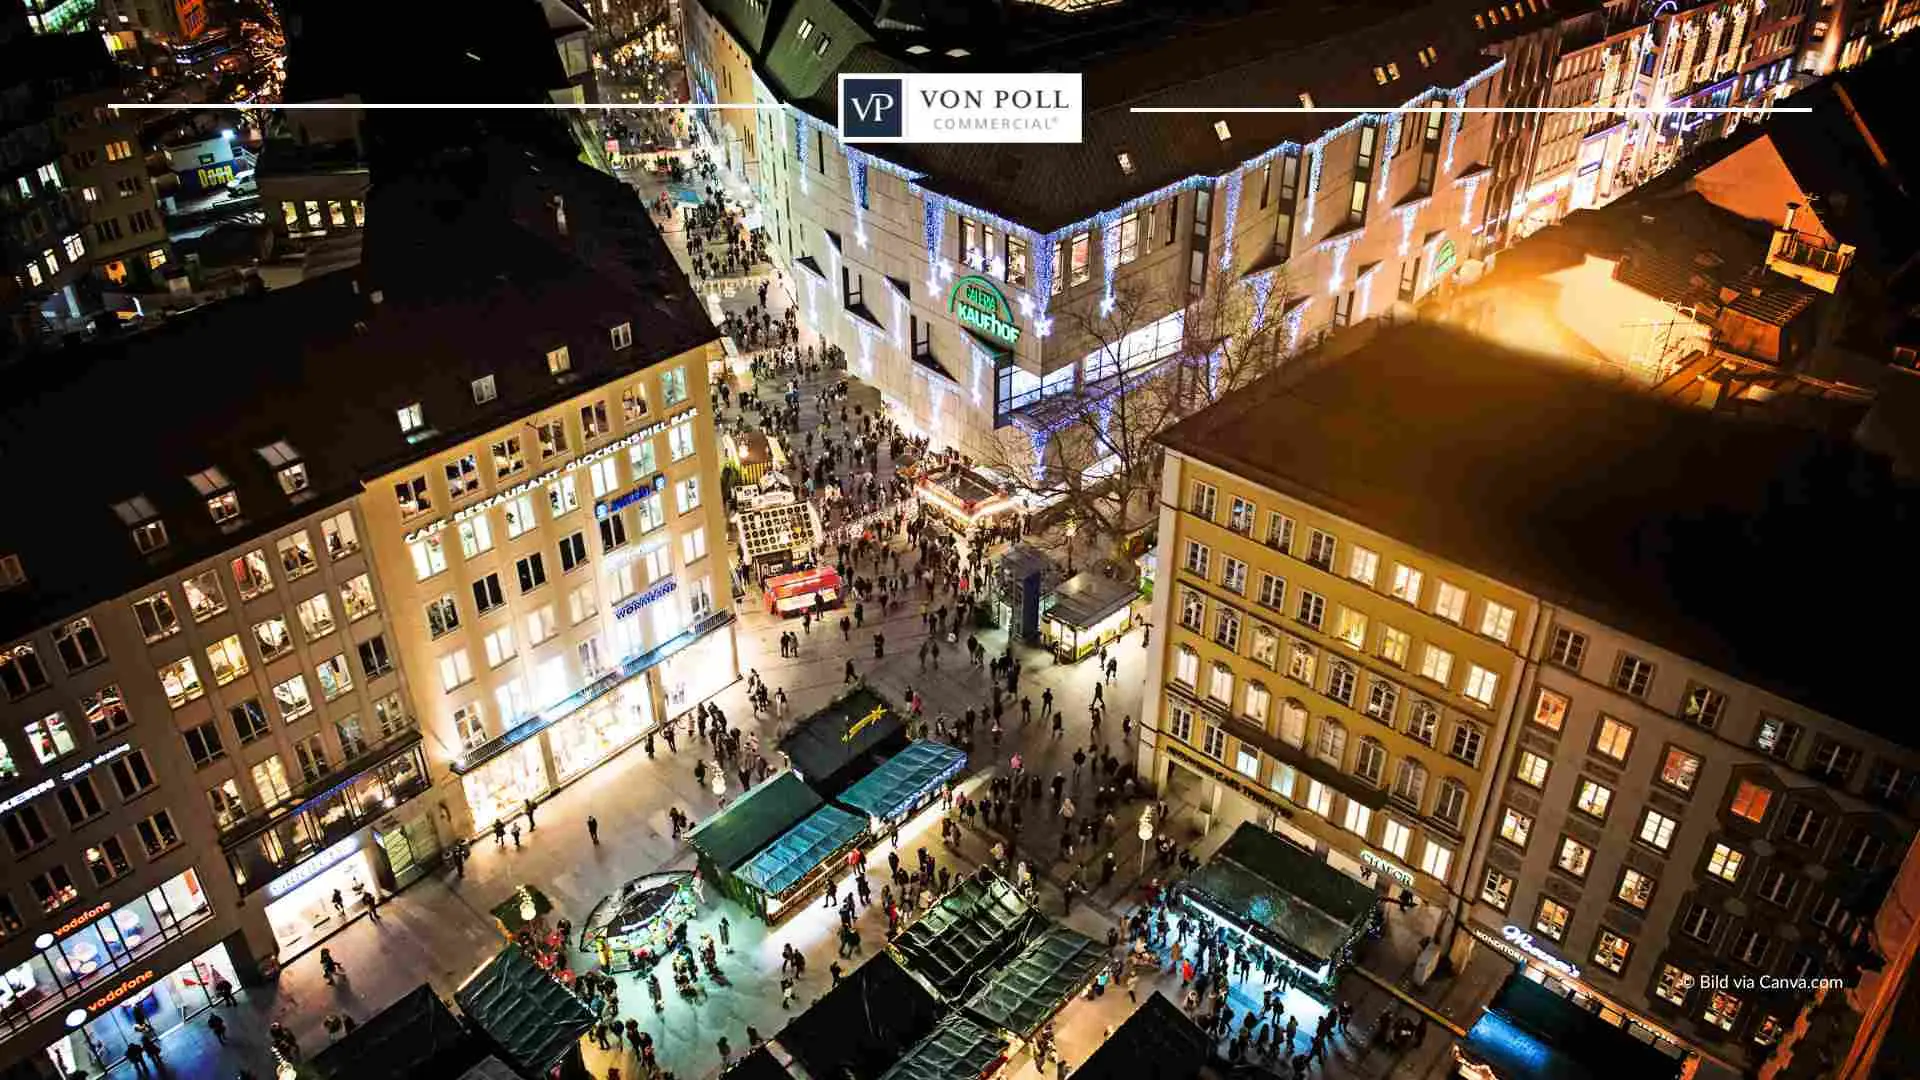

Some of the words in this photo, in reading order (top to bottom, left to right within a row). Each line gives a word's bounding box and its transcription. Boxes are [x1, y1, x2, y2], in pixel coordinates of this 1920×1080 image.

[454, 470, 561, 522] RESTAURANT
[565, 423, 671, 472] GLOCKENSPIEL
[670, 407, 699, 427] BAR
[54, 901, 113, 937] vodafone
[88, 970, 154, 1012] vodafone
